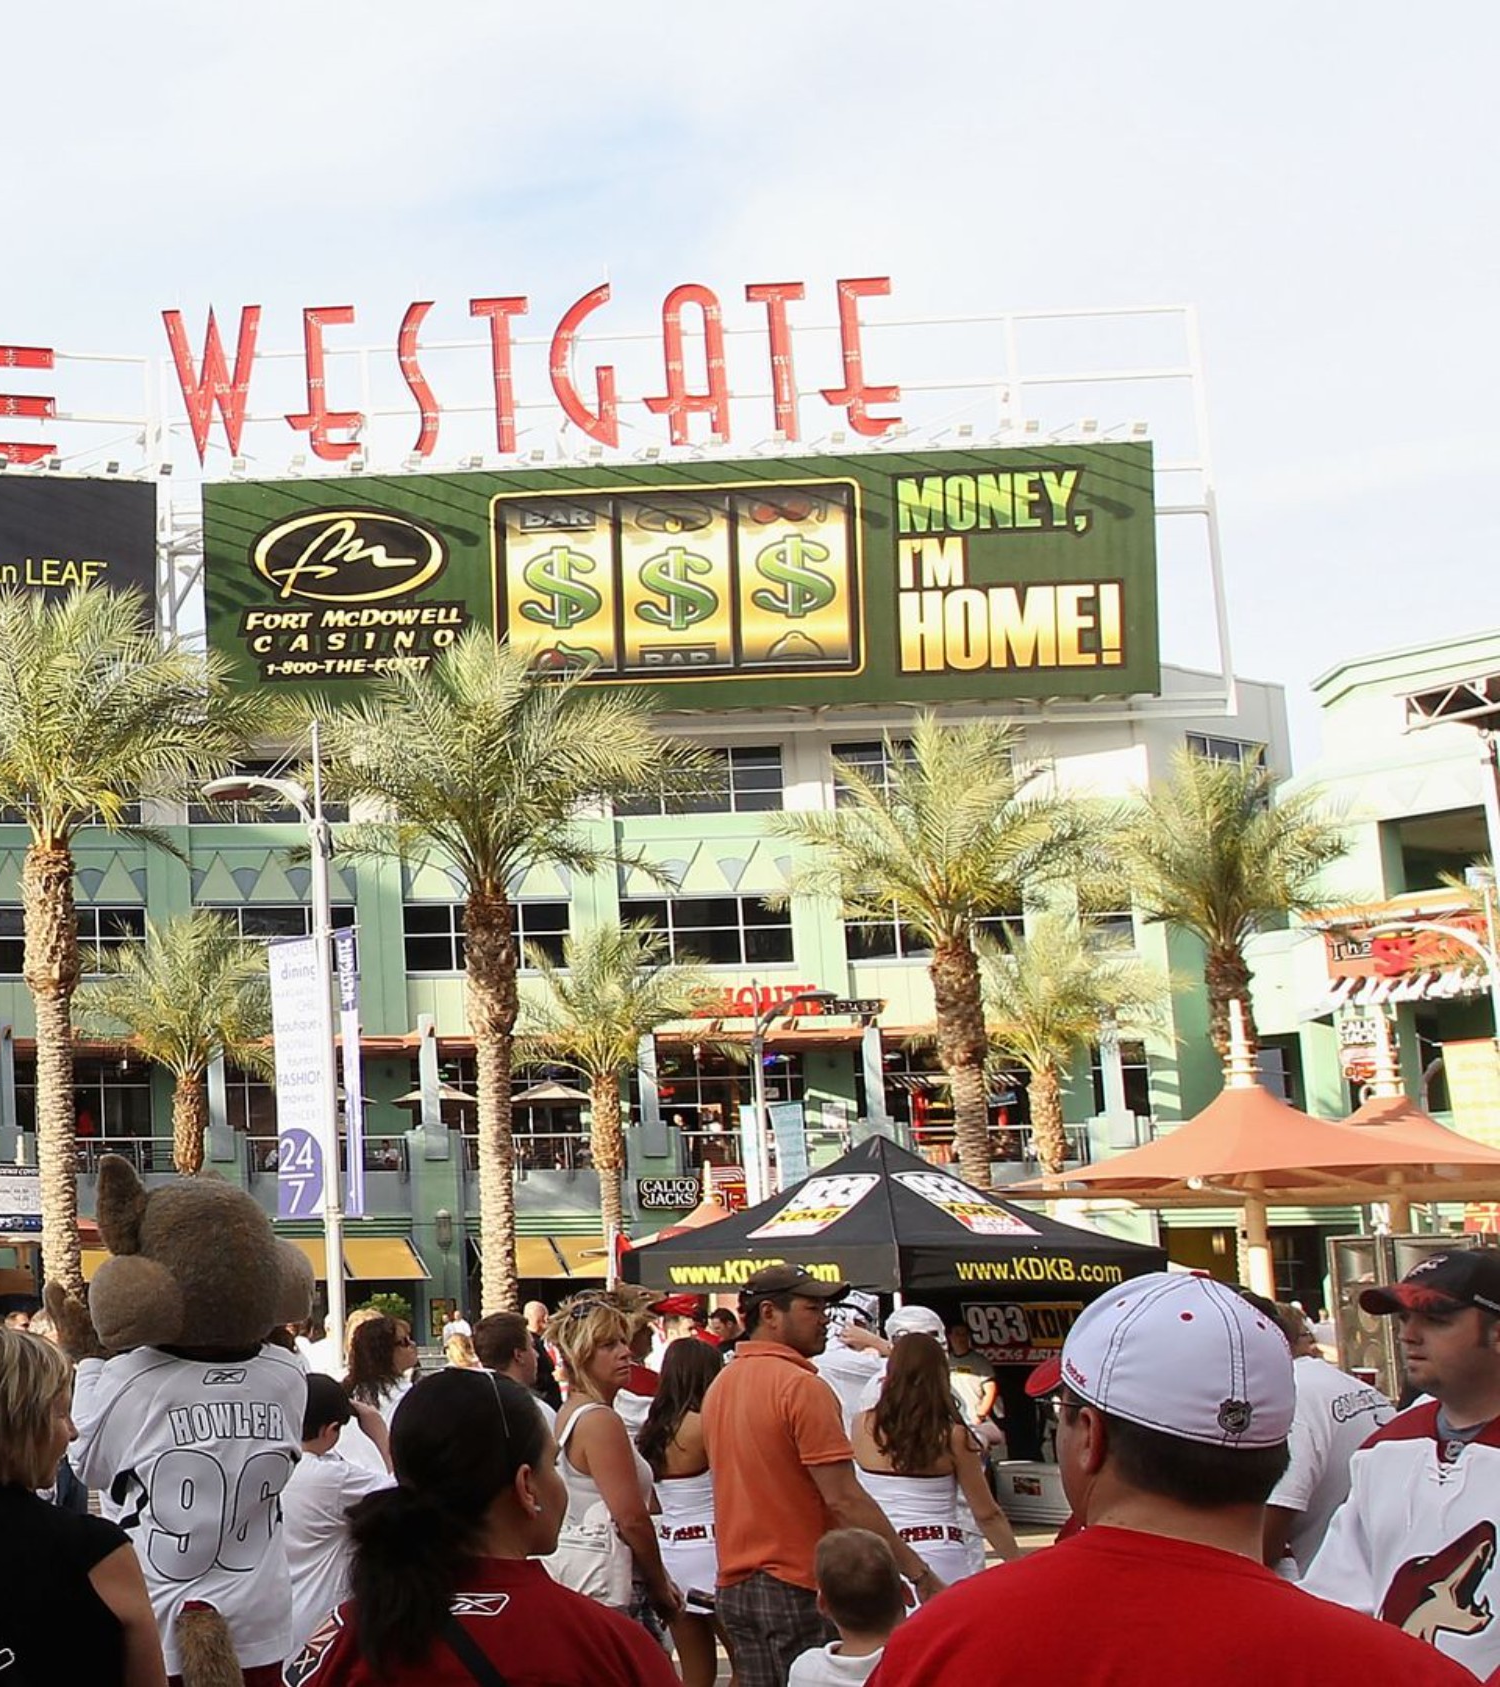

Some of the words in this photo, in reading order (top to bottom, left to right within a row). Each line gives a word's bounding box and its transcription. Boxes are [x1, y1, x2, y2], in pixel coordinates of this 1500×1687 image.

[162, 276, 903, 468] WESTGATE
[524, 507, 592, 527] BAR
[899, 469, 1087, 533] MONEY,
[899, 537, 965, 588] I'M
[246, 611, 314, 631] FORT
[900, 583, 1122, 673] HOME!
[253, 628, 456, 653] CASINO
[266, 656, 431, 675] 1-800-THE-FORT
[1329, 939, 1373, 961] The
[279, 1136, 315, 1173] 24
[288, 1181, 307, 1215] 7
[643, 1180, 696, 1193] CALICO
[647, 1193, 695, 1206] JACKS
[956, 1257, 1123, 1282] www.KDKB.com
[966, 1305, 1029, 1345] 933
[1029, 1308, 1080, 1340] KDK
[168, 1401, 284, 1446] HOWLER
[148, 1449, 290, 1582] 96
